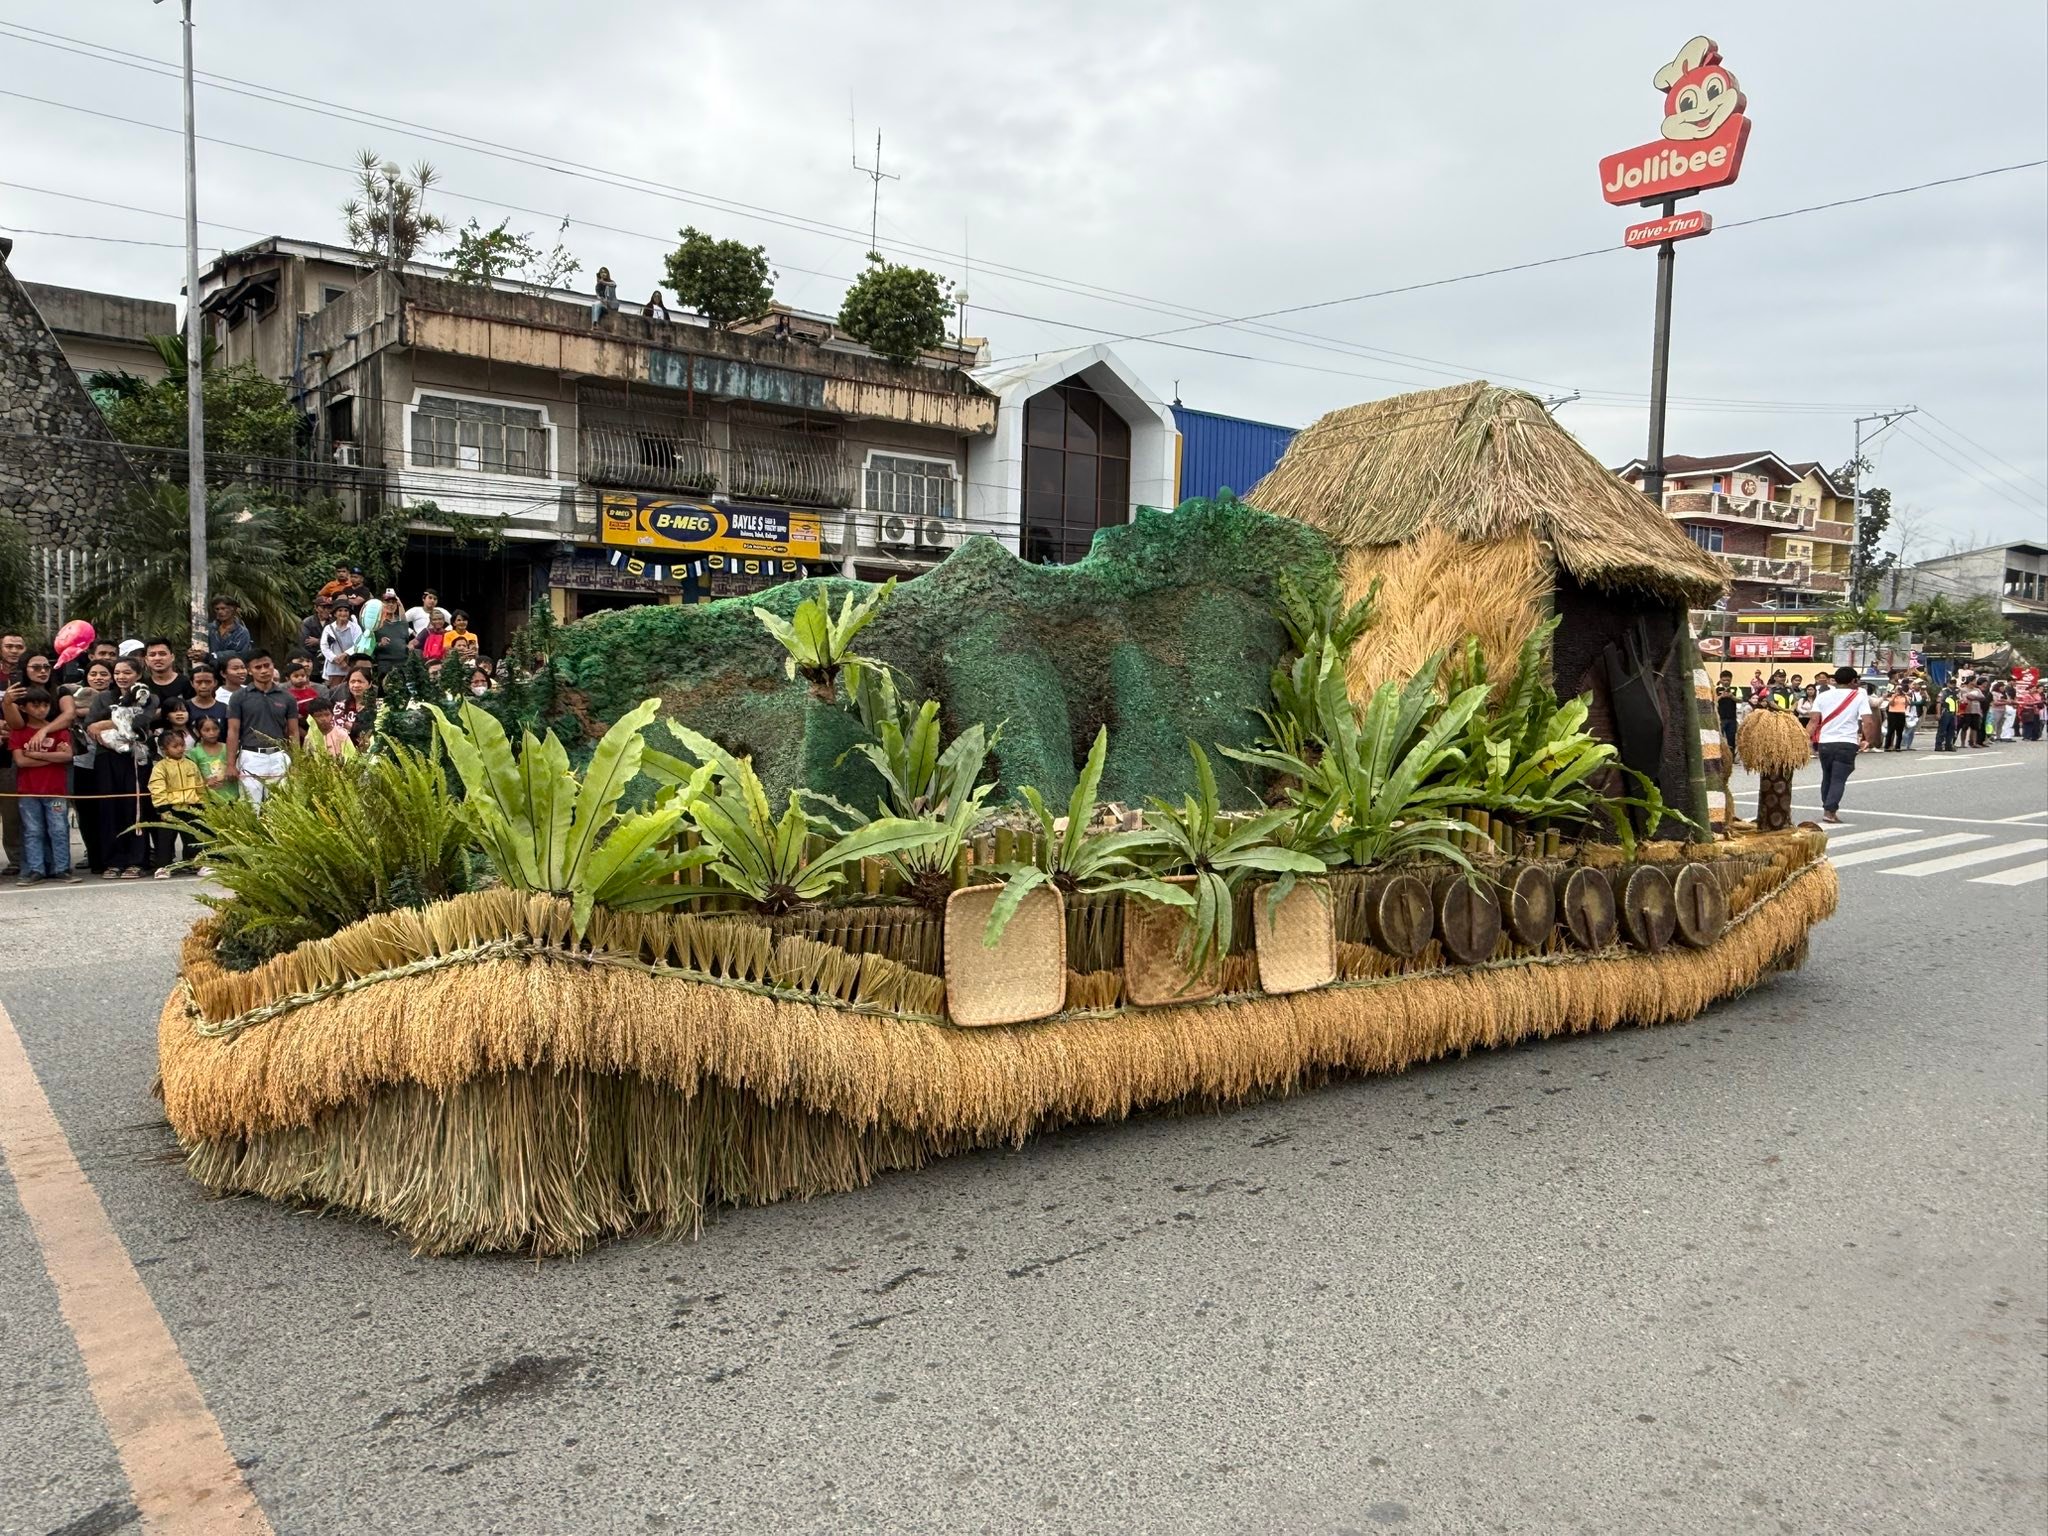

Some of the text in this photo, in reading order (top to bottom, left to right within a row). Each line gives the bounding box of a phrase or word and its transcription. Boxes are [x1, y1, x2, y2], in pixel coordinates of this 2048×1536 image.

[1605, 145, 1727, 193] Jollibee
[1627, 217, 1699, 242] Drive-Thru
[656, 513, 709, 532] B-MEG
